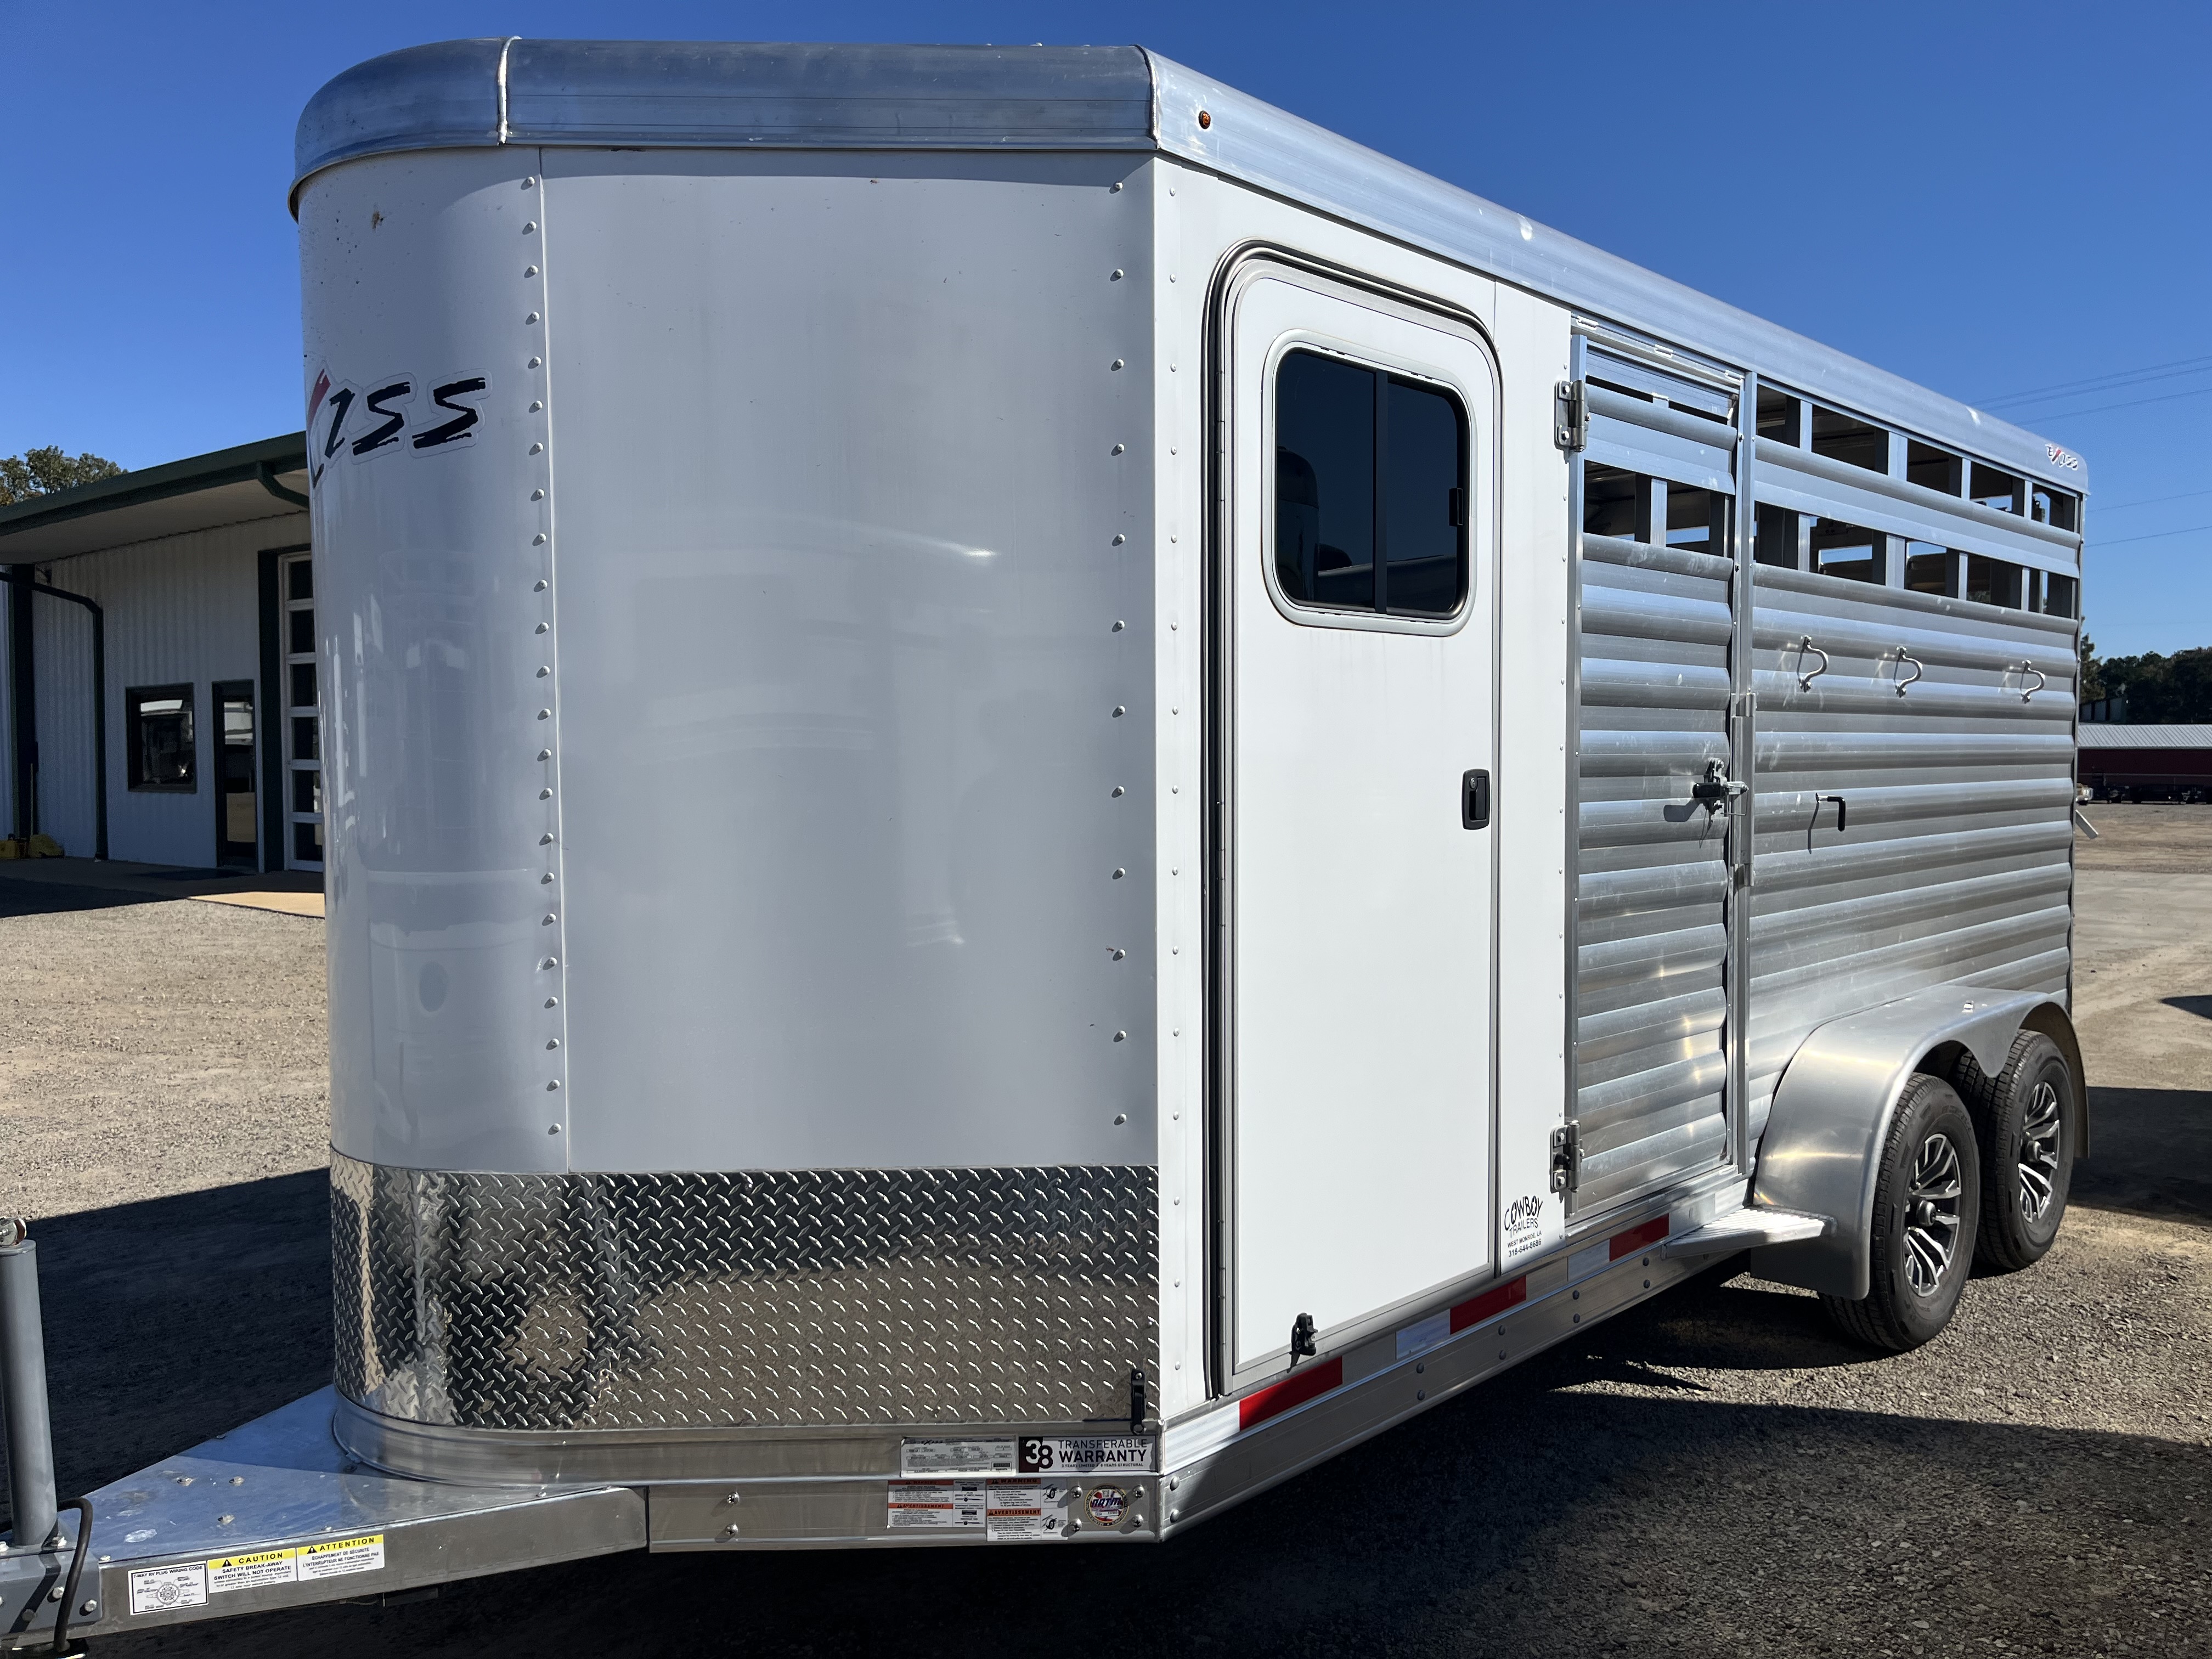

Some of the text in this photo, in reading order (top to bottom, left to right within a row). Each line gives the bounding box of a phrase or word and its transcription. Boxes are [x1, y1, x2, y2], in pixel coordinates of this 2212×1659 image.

[1504, 1195, 1543, 1231] COWBOY
[1509, 1218, 1538, 1238] TRAILERS
[1508, 1239, 1518, 1248] WEST
[1058, 1439, 1147, 1449] TRANSFERABLE
[1058, 1449, 1147, 1463] WARRANTY
[320, 1537, 375, 1551] ATTENTION
[239, 1552, 283, 1564] CAUTION
[246, 1561, 283, 1570] BREAK-AWAY
